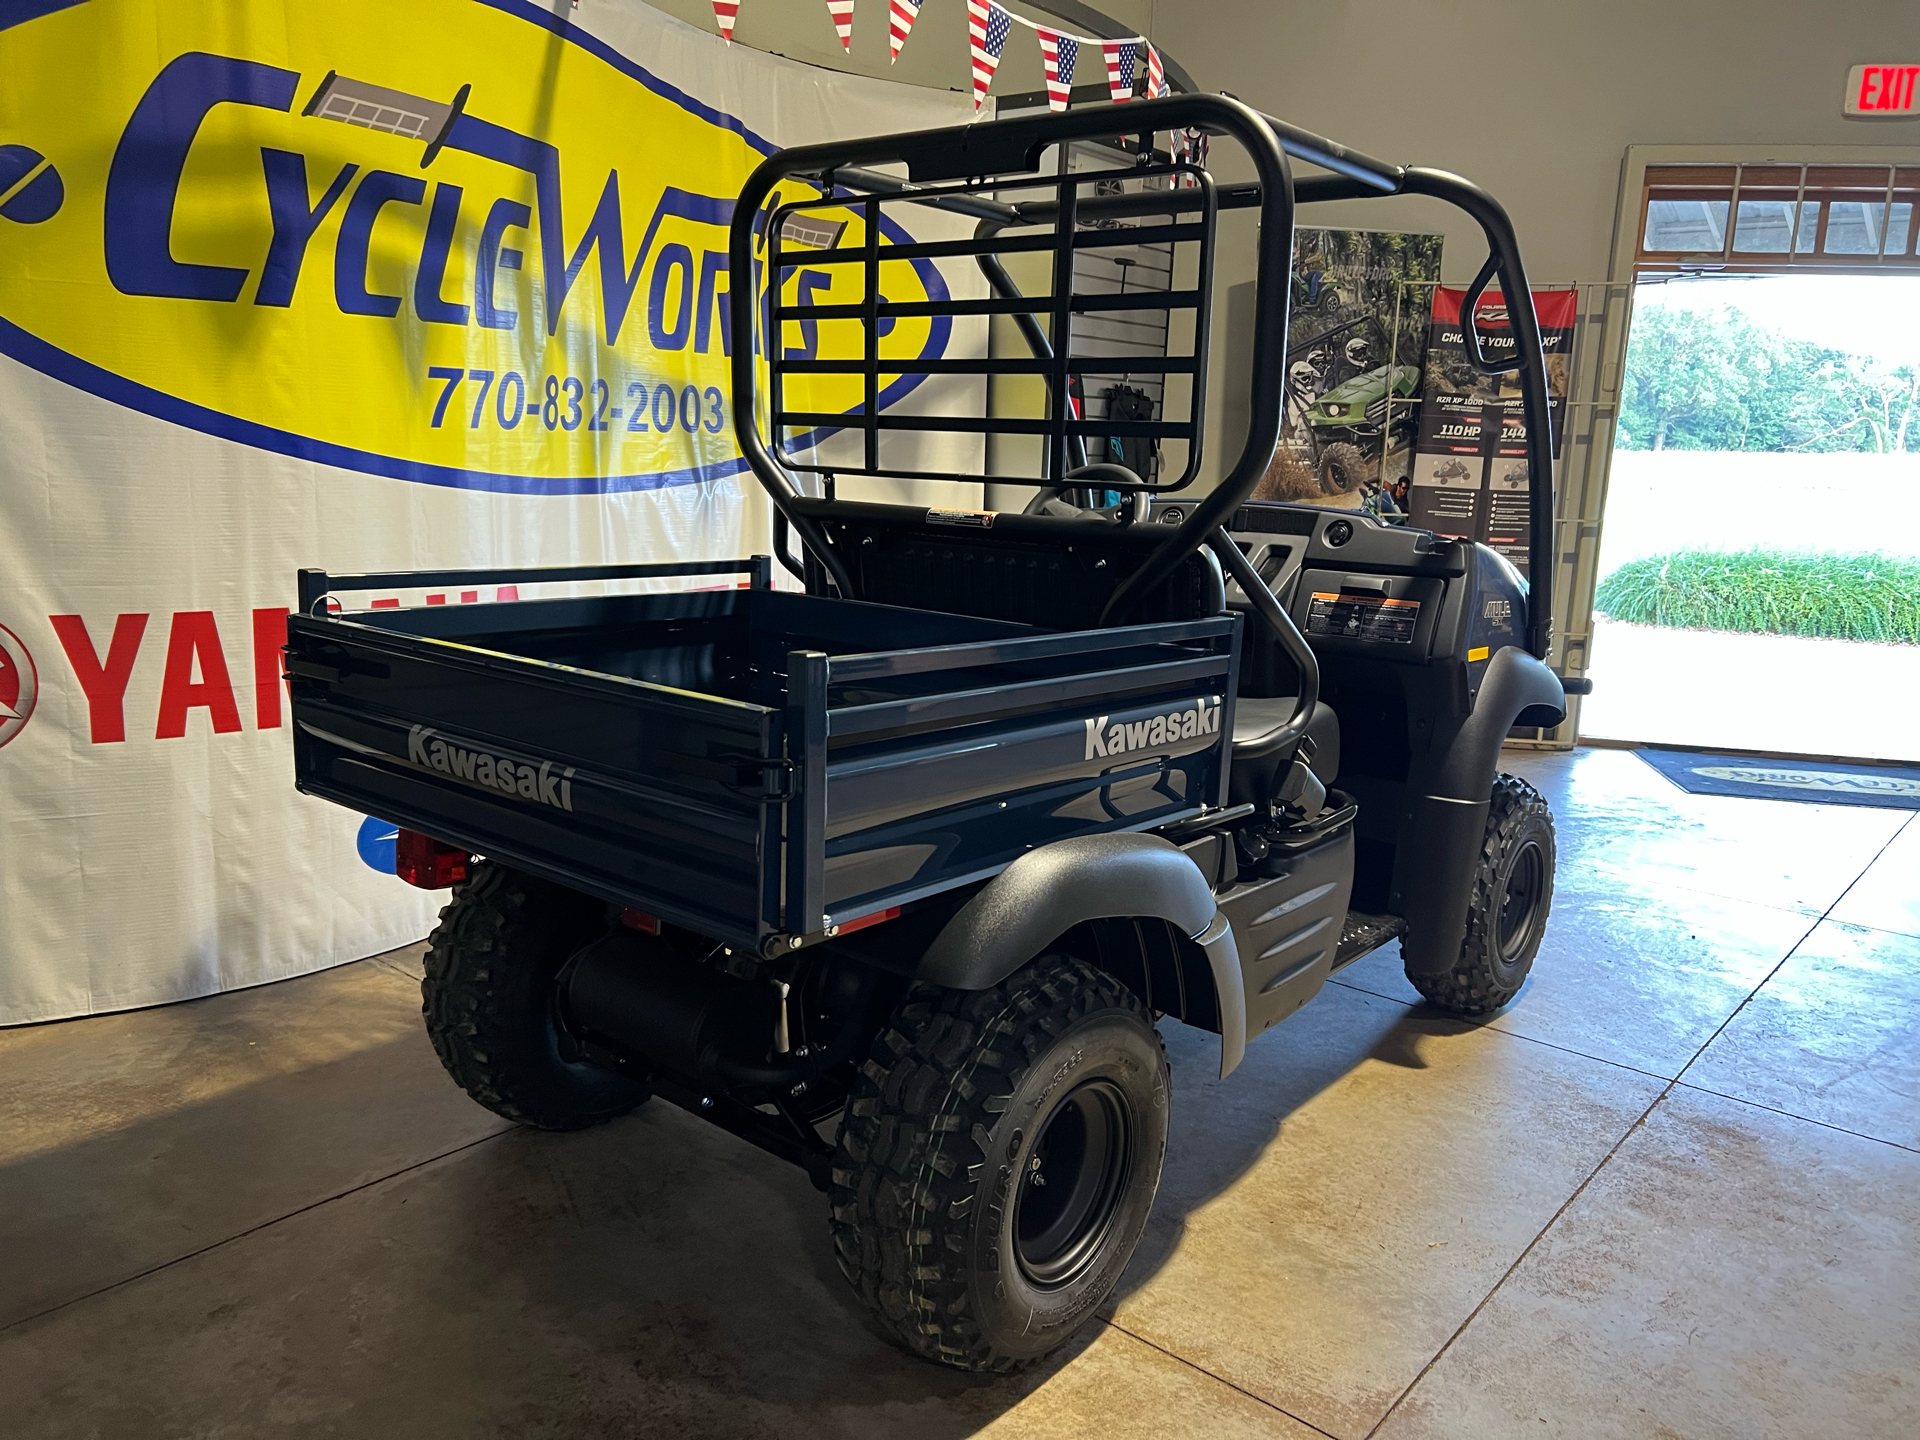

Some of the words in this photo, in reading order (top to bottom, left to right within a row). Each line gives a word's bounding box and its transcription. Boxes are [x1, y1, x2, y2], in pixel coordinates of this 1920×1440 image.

[1858, 67, 1920, 110] EXIT
[427, 366, 724, 434] 770-832-2003
[1436, 396, 1451, 404] RZR
[1463, 398, 1484, 406] 1000
[1440, 424, 1462, 436] 110
[1463, 426, 1481, 437] HP
[1501, 427, 1527, 439] 144
[1483, 600, 1512, 619] MULE
[1084, 695, 1221, 761] Kawasaki
[407, 723, 577, 813] Kawasaki
